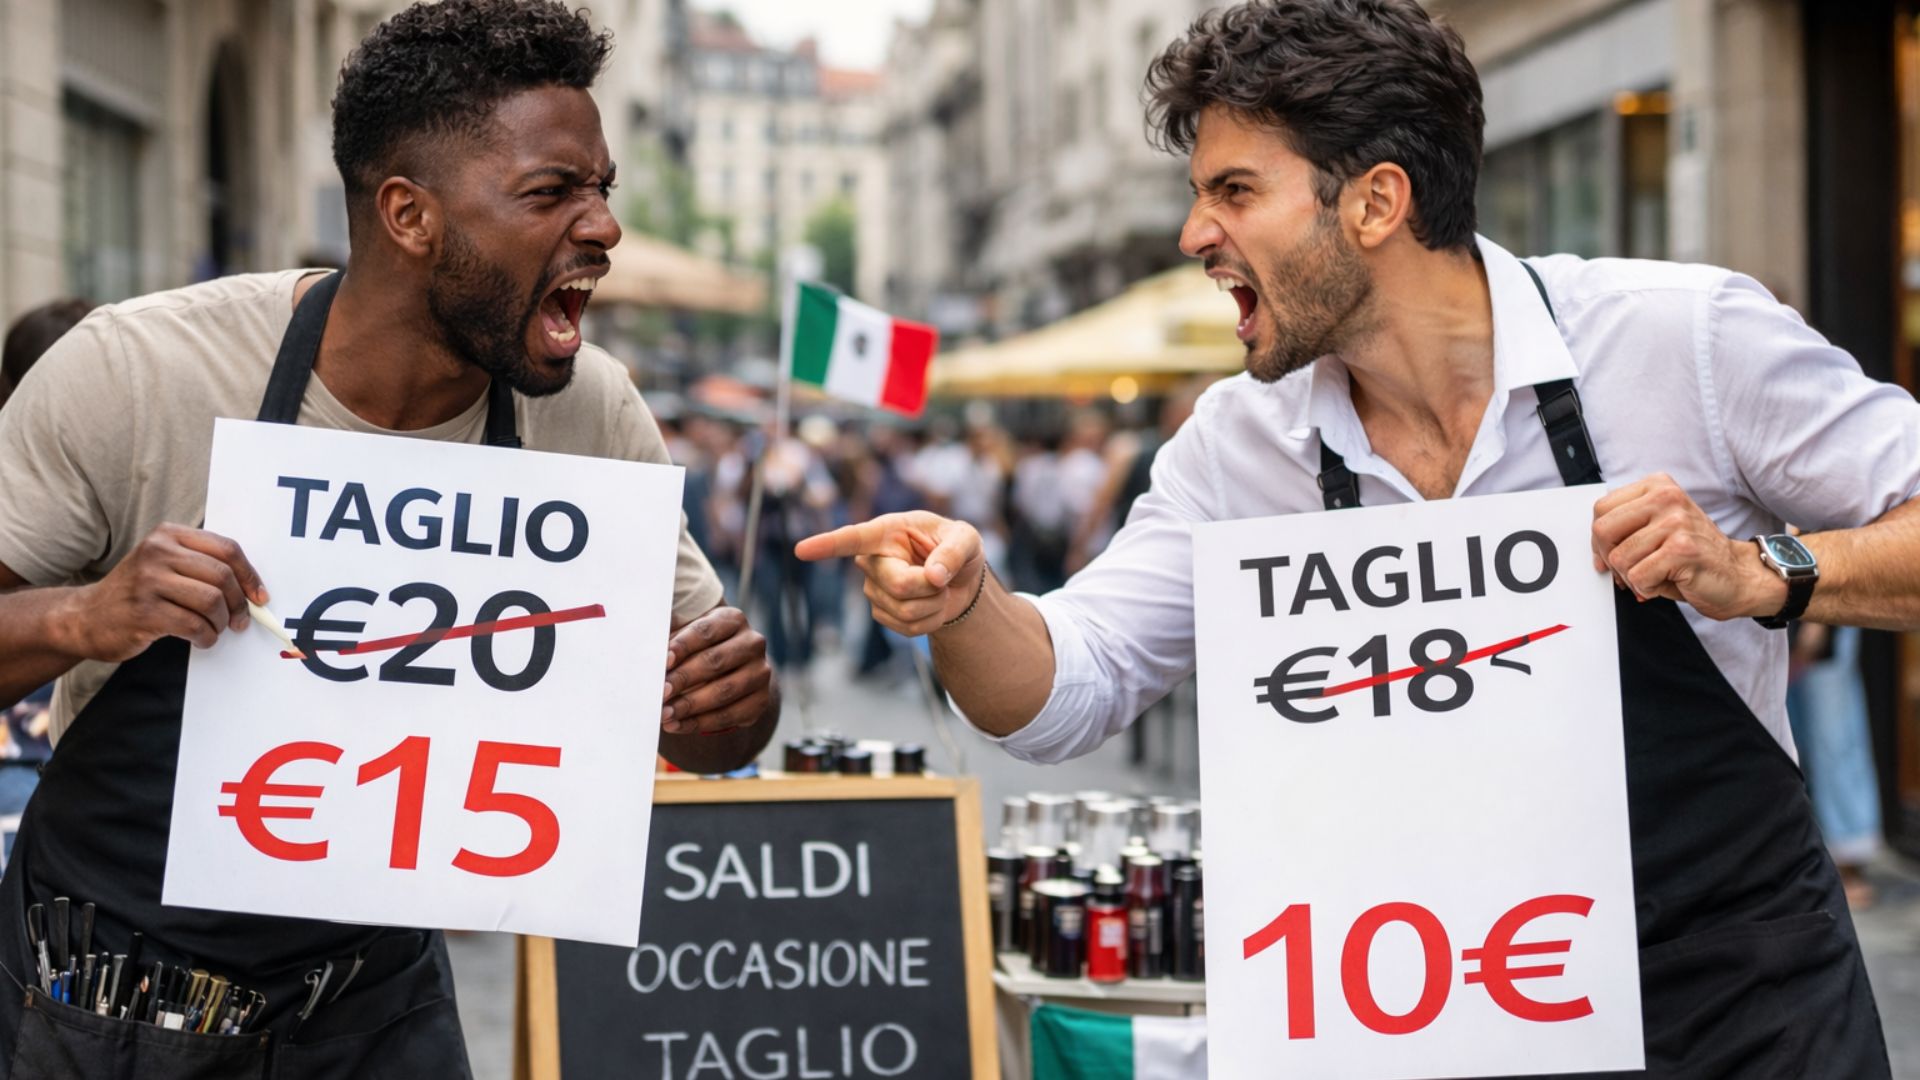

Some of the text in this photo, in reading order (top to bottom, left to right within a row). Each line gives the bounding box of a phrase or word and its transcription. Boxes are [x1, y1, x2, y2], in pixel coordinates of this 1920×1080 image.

[277, 475, 589, 563] TAGLIO
[1239, 530, 1560, 618] TAGLIO
[284, 582, 556, 692] €20
[1253, 628, 1475, 724] €18
[218, 735, 562, 878] €15
[664, 841, 871, 901] SALDI
[627, 938, 931, 993] OCCASIONE
[1243, 894, 1596, 1040] 10€
[642, 1022, 918, 1080] TAGLIO
